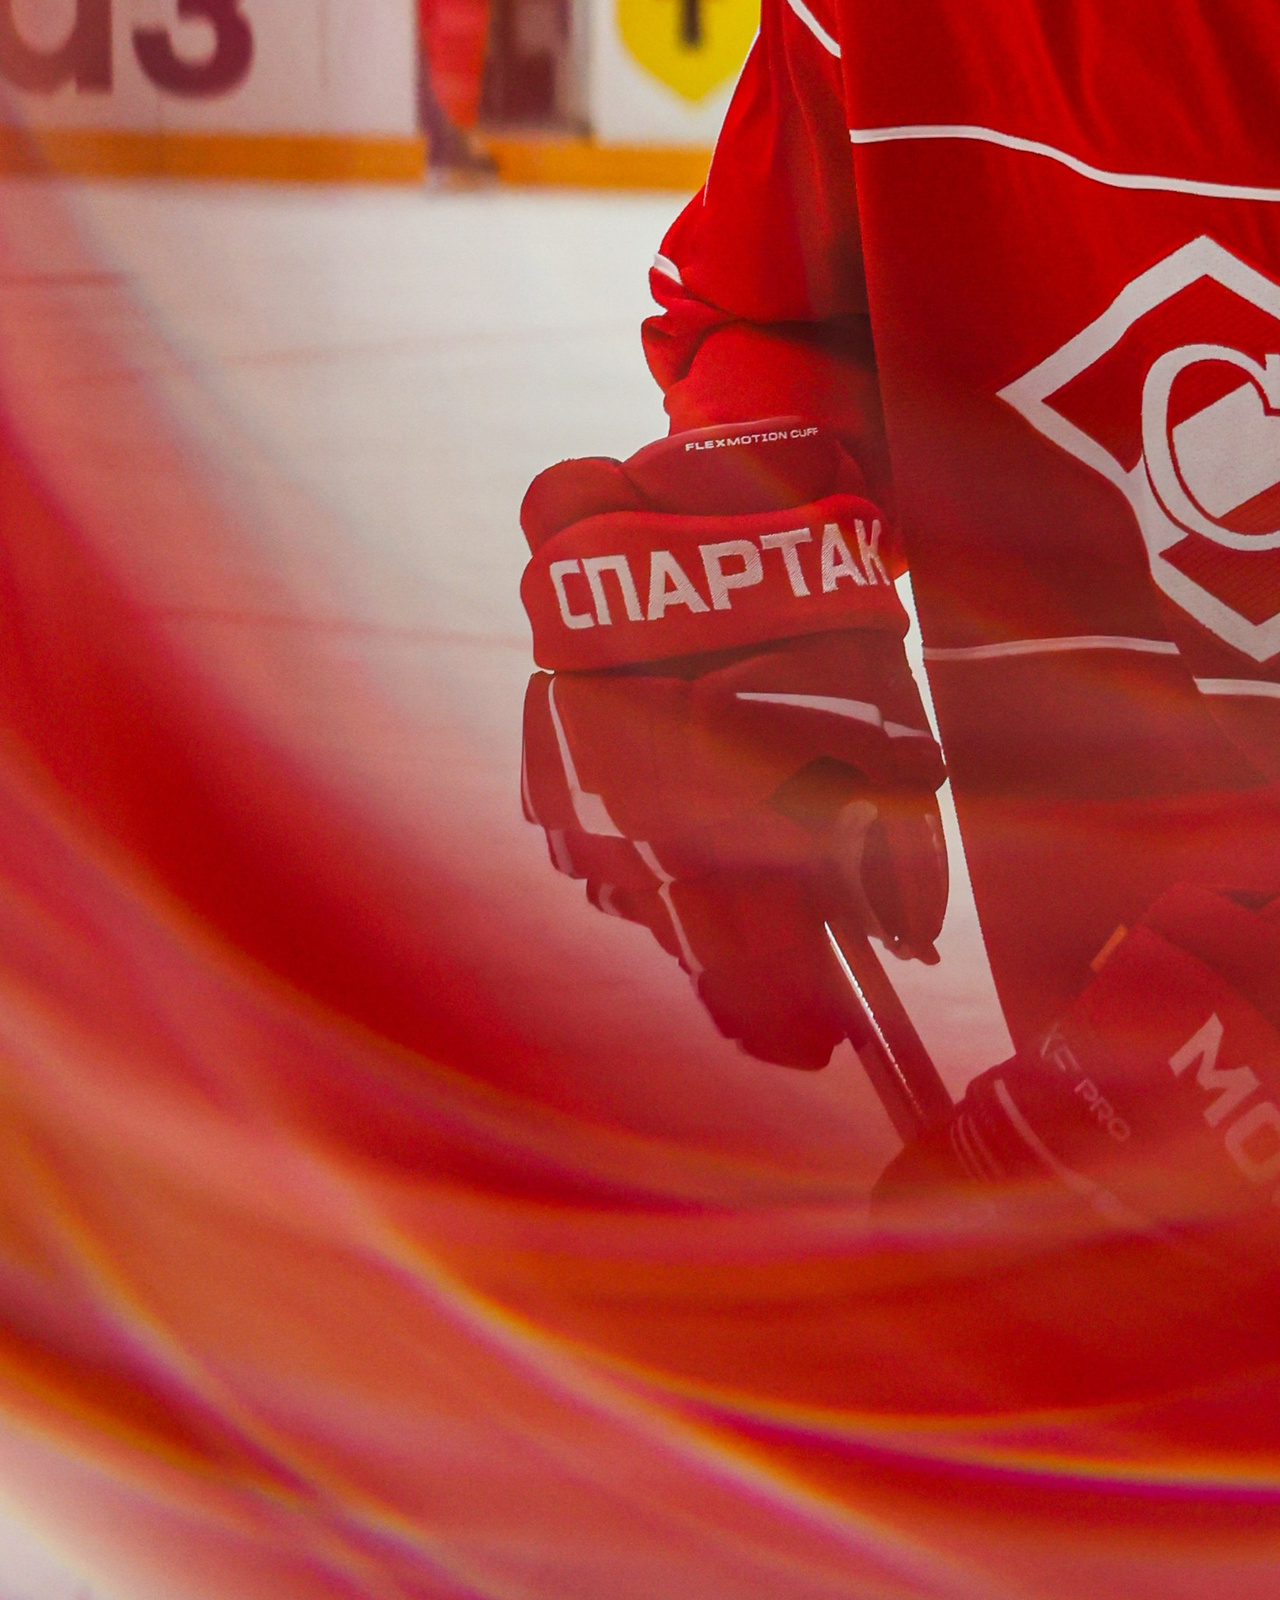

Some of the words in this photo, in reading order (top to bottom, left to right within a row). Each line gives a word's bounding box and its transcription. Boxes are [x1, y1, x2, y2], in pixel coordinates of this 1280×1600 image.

[685, 430, 788, 452] FLEXMOTION
[789, 426, 819, 439] CUFF
[549, 518, 890, 630] СПАРТАК
